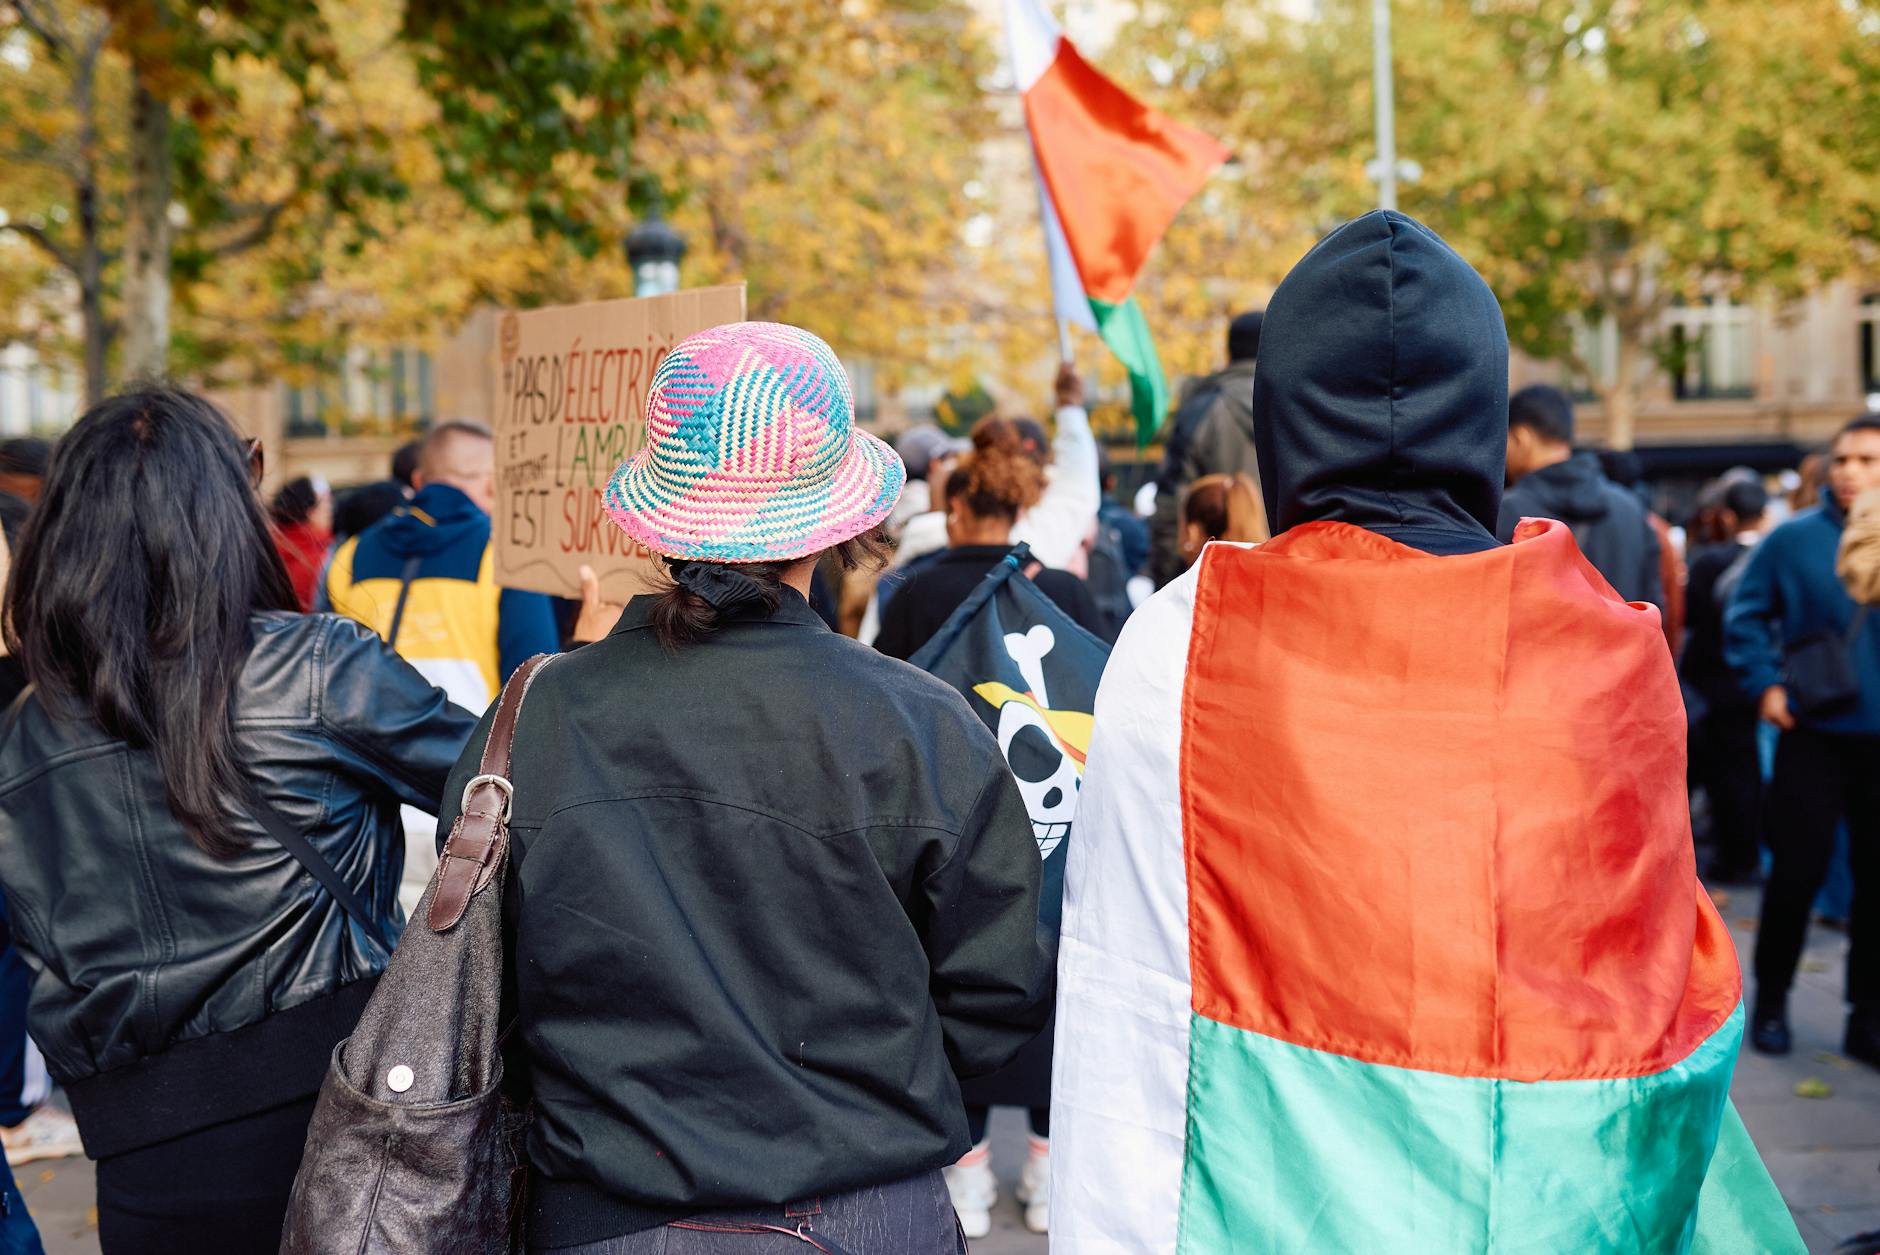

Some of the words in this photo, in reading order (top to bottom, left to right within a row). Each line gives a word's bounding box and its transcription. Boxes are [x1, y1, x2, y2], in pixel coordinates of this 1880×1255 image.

[512, 354, 548, 425] PAS
[548, 334, 674, 424] D'ÉLECTRI
[509, 430, 528, 460] ET
[511, 489, 549, 549] EST
[560, 488, 649, 559] SURV
